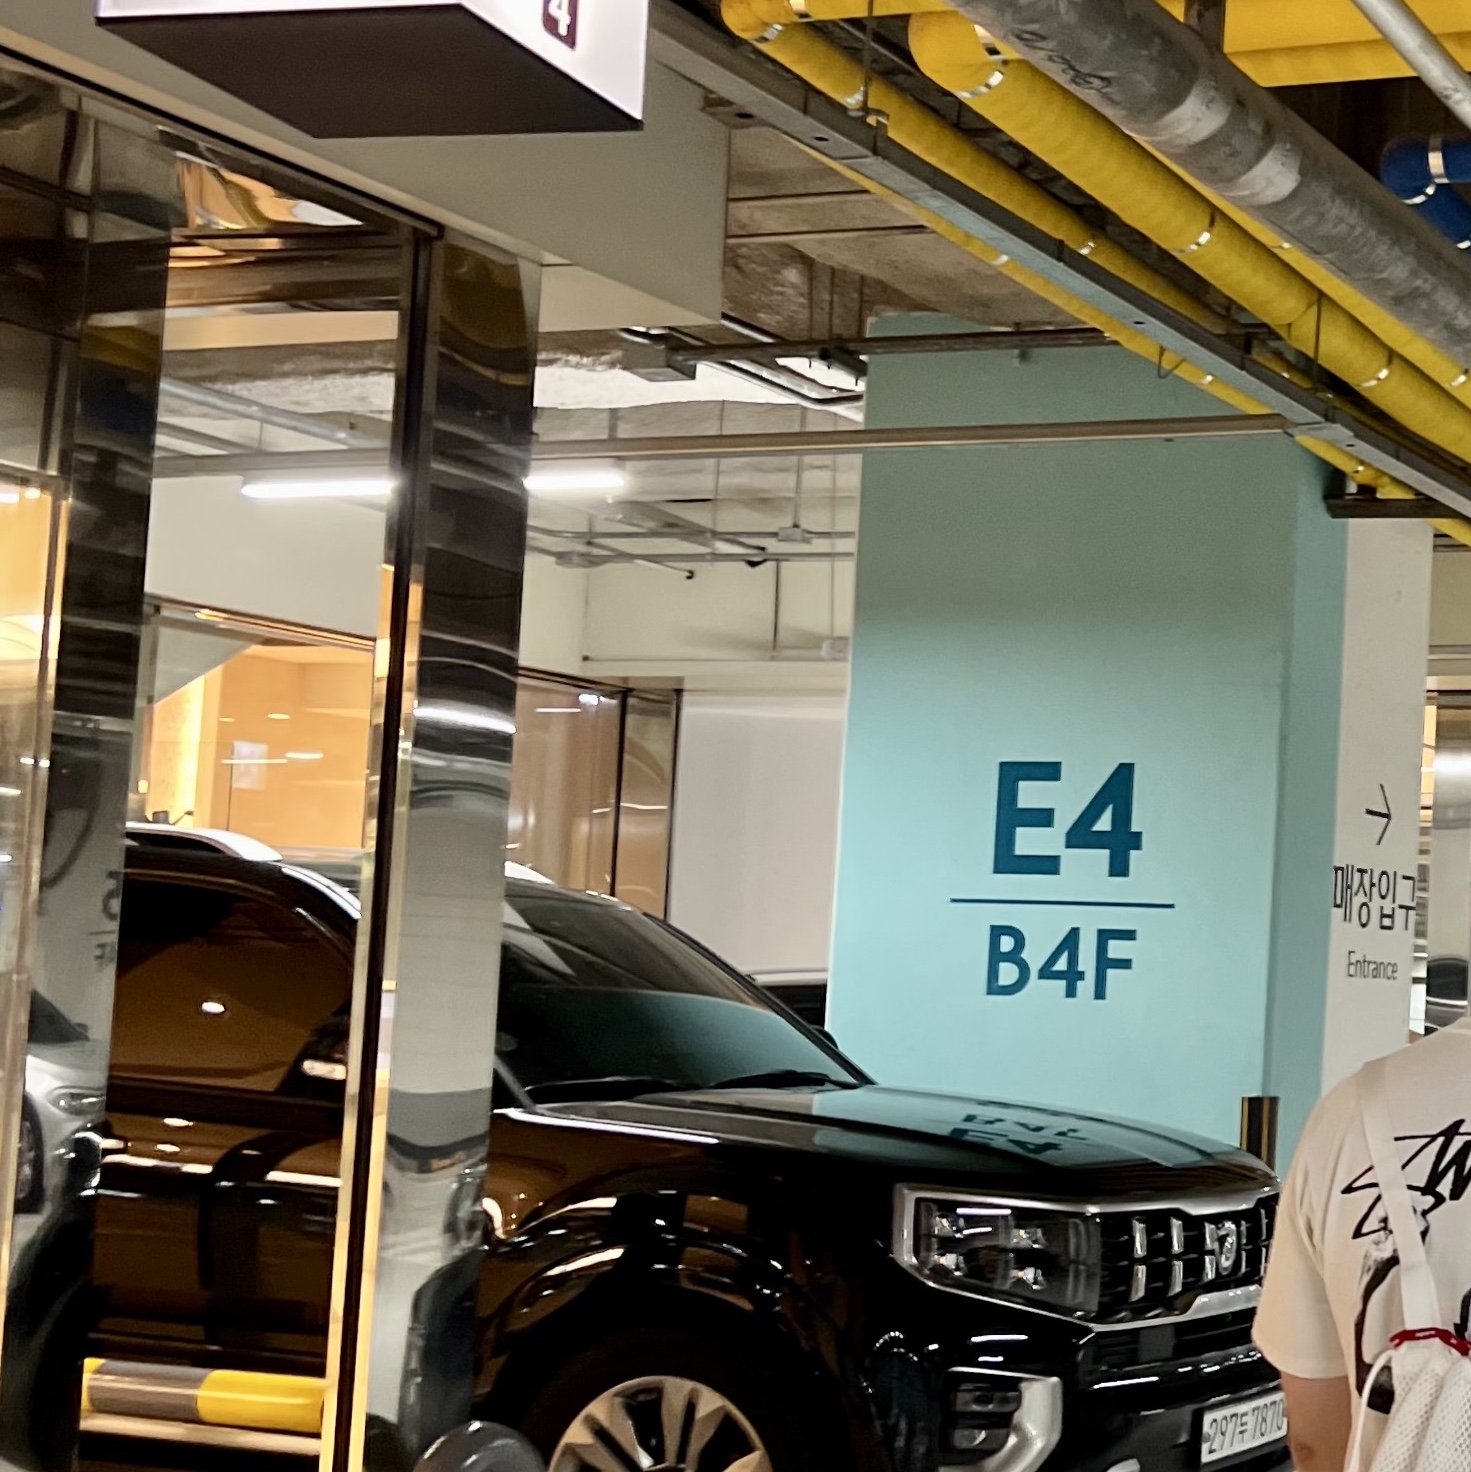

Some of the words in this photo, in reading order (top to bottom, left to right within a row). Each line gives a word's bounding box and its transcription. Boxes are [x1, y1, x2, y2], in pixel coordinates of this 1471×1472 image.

[547, 0, 572, 37] 4
[993, 761, 1143, 877] E4
[1333, 864, 1416, 931] 매장입구
[986, 924, 1137, 1000] B4F
[1347, 950, 1398, 980] Entrance
